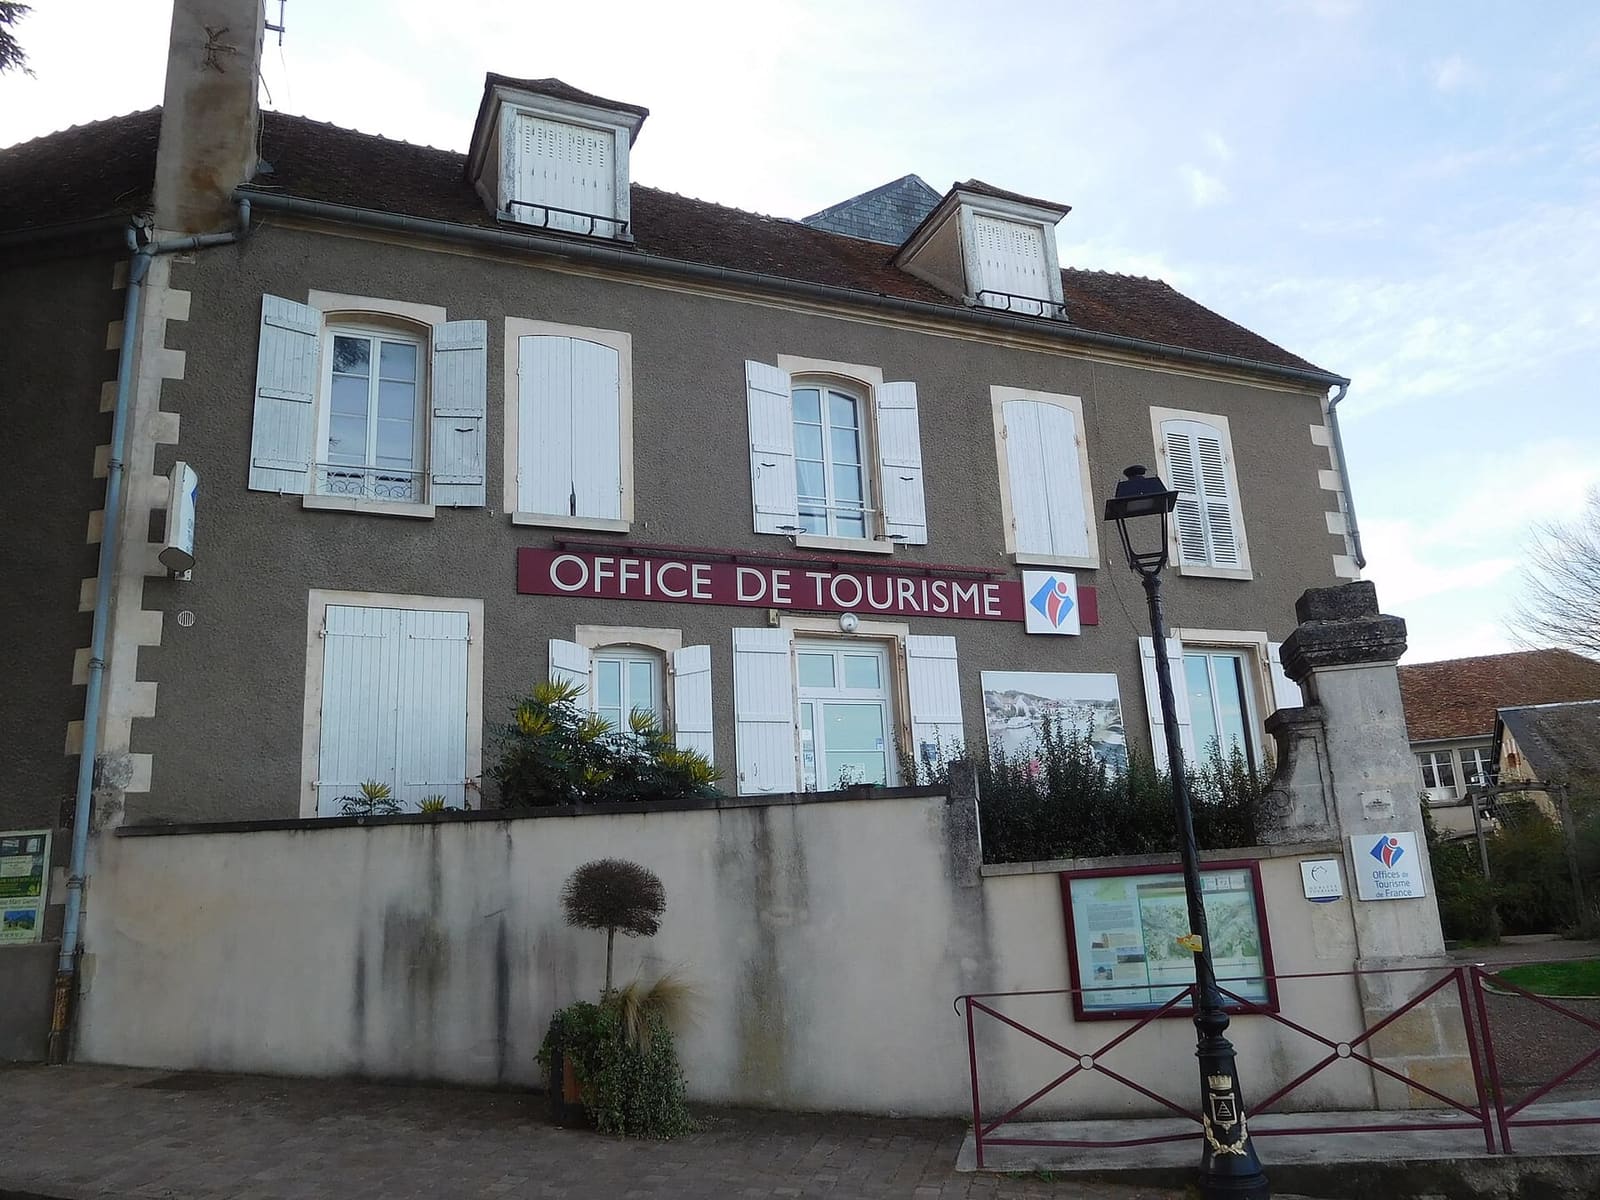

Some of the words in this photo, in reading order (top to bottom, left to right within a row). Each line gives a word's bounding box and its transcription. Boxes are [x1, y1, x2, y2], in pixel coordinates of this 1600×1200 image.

[549, 555, 713, 599] OFFICE
[737, 569, 792, 603] DE
[805, 572, 1001, 615] TOURISME
[1372, 870, 1400, 879] Offices
[1374, 880, 1411, 888] Tourisme
[1385, 888, 1412, 897] France
